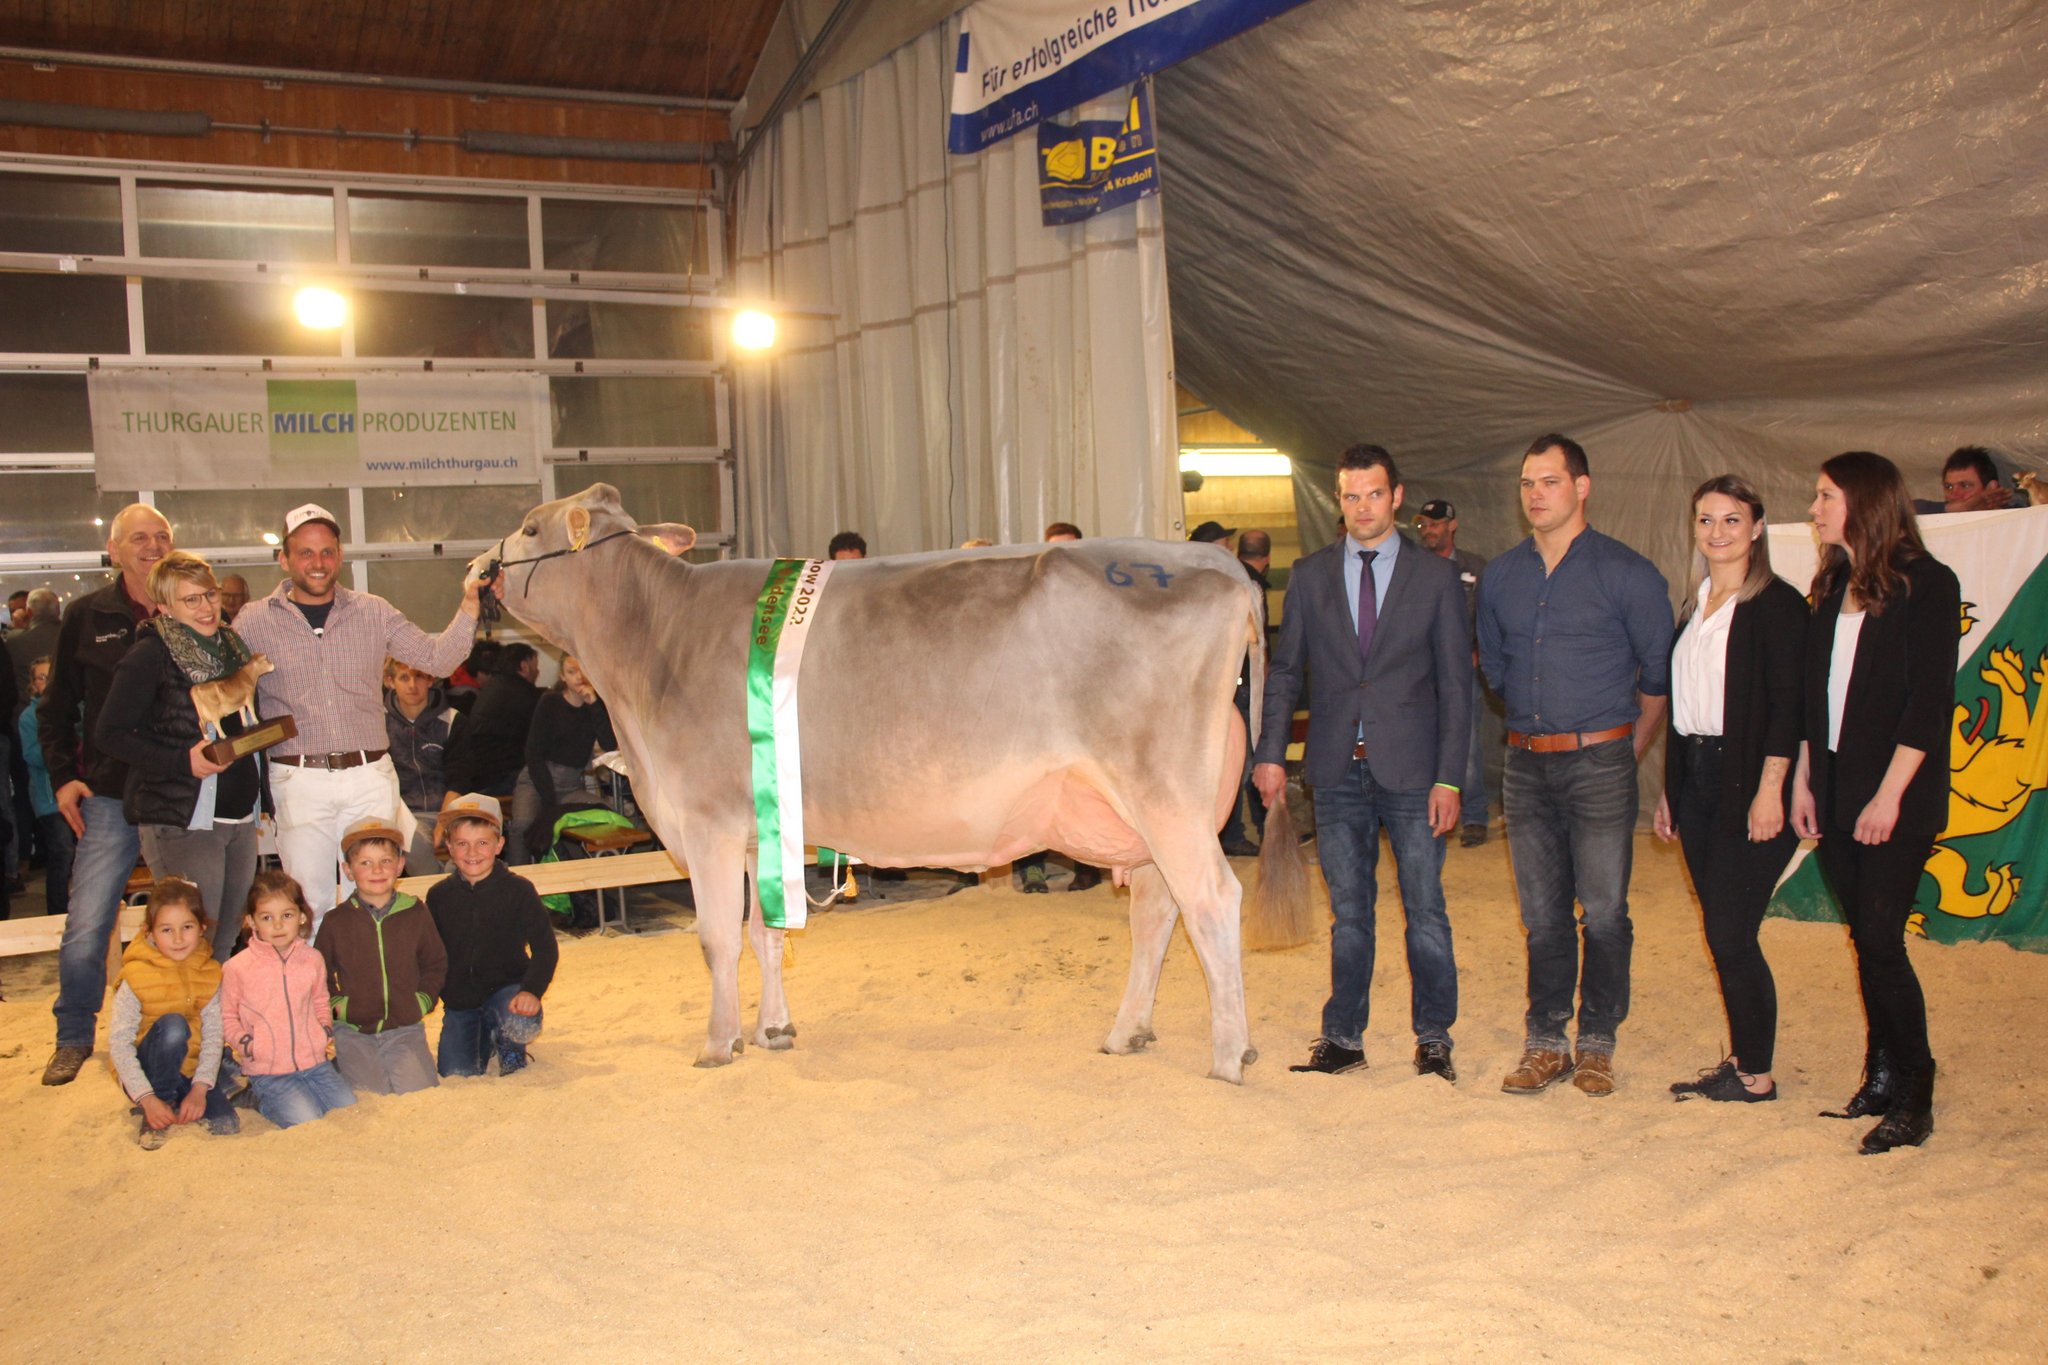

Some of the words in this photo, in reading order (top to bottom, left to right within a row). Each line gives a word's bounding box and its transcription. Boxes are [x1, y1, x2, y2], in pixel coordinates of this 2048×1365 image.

[983, 66, 1007, 98] Für
[1013, 6, 1117, 80] erfolgreiche
[981, 100, 1039, 142] www.ufa.ch
[1115, 167, 1152, 188] Kradolf
[122, 412, 264, 433] THURGAUER
[274, 412, 354, 434] MILCH
[363, 411, 516, 432] PRODUZENTEN
[366, 457, 518, 471] www.milchthurgau.ch
[1105, 560, 1174, 588] 67
